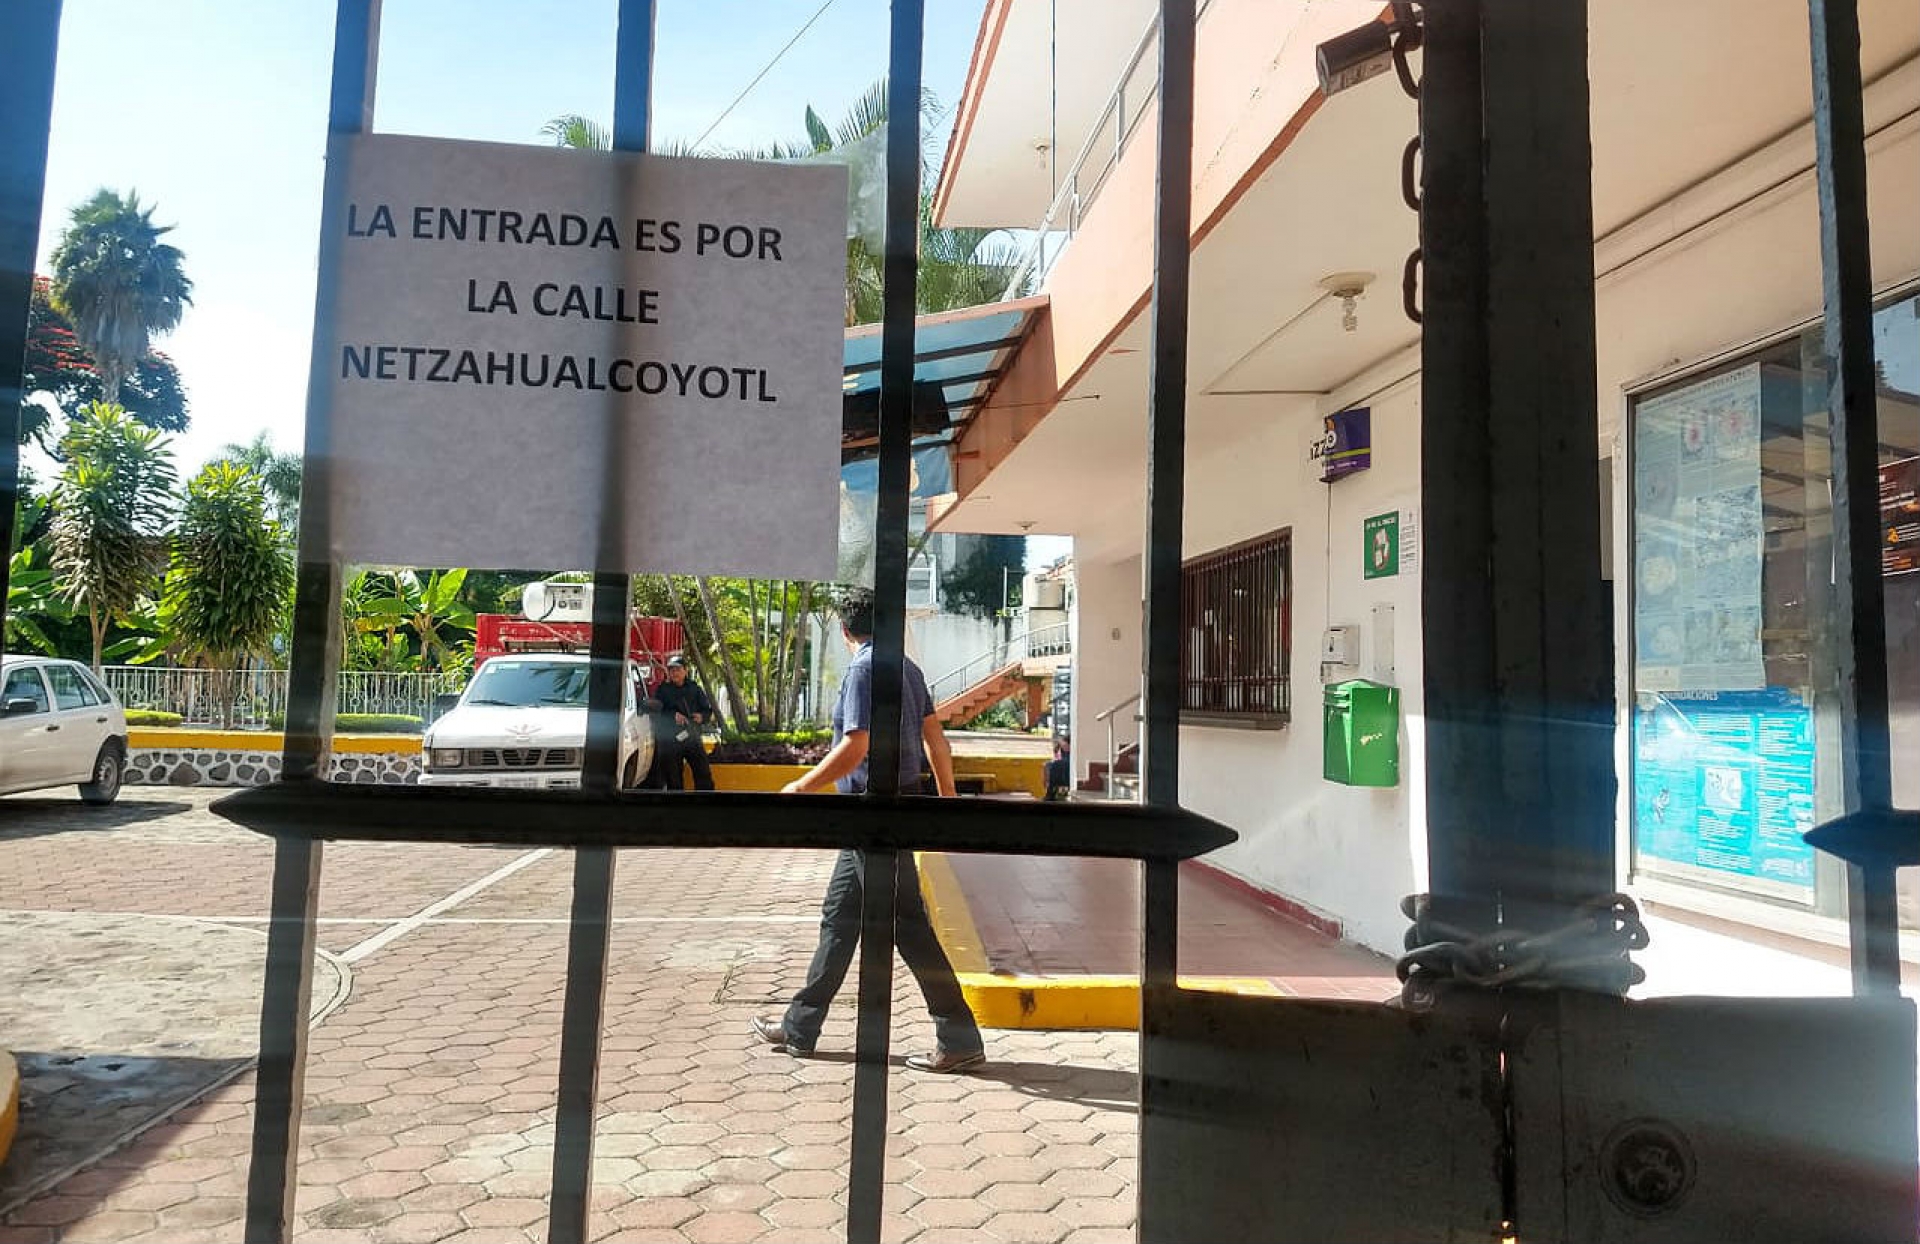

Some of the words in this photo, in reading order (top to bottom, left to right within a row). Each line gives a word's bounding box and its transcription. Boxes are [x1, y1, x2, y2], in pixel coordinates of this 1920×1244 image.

[347, 203, 397, 238] LA
[412, 206, 621, 253] ENTRADA
[635, 218, 682, 254] ES
[696, 223, 783, 262] POR
[467, 278, 518, 315] LA
[532, 282, 660, 325] CALLE
[341, 345, 778, 403] NETZAHUALCOYOTL
